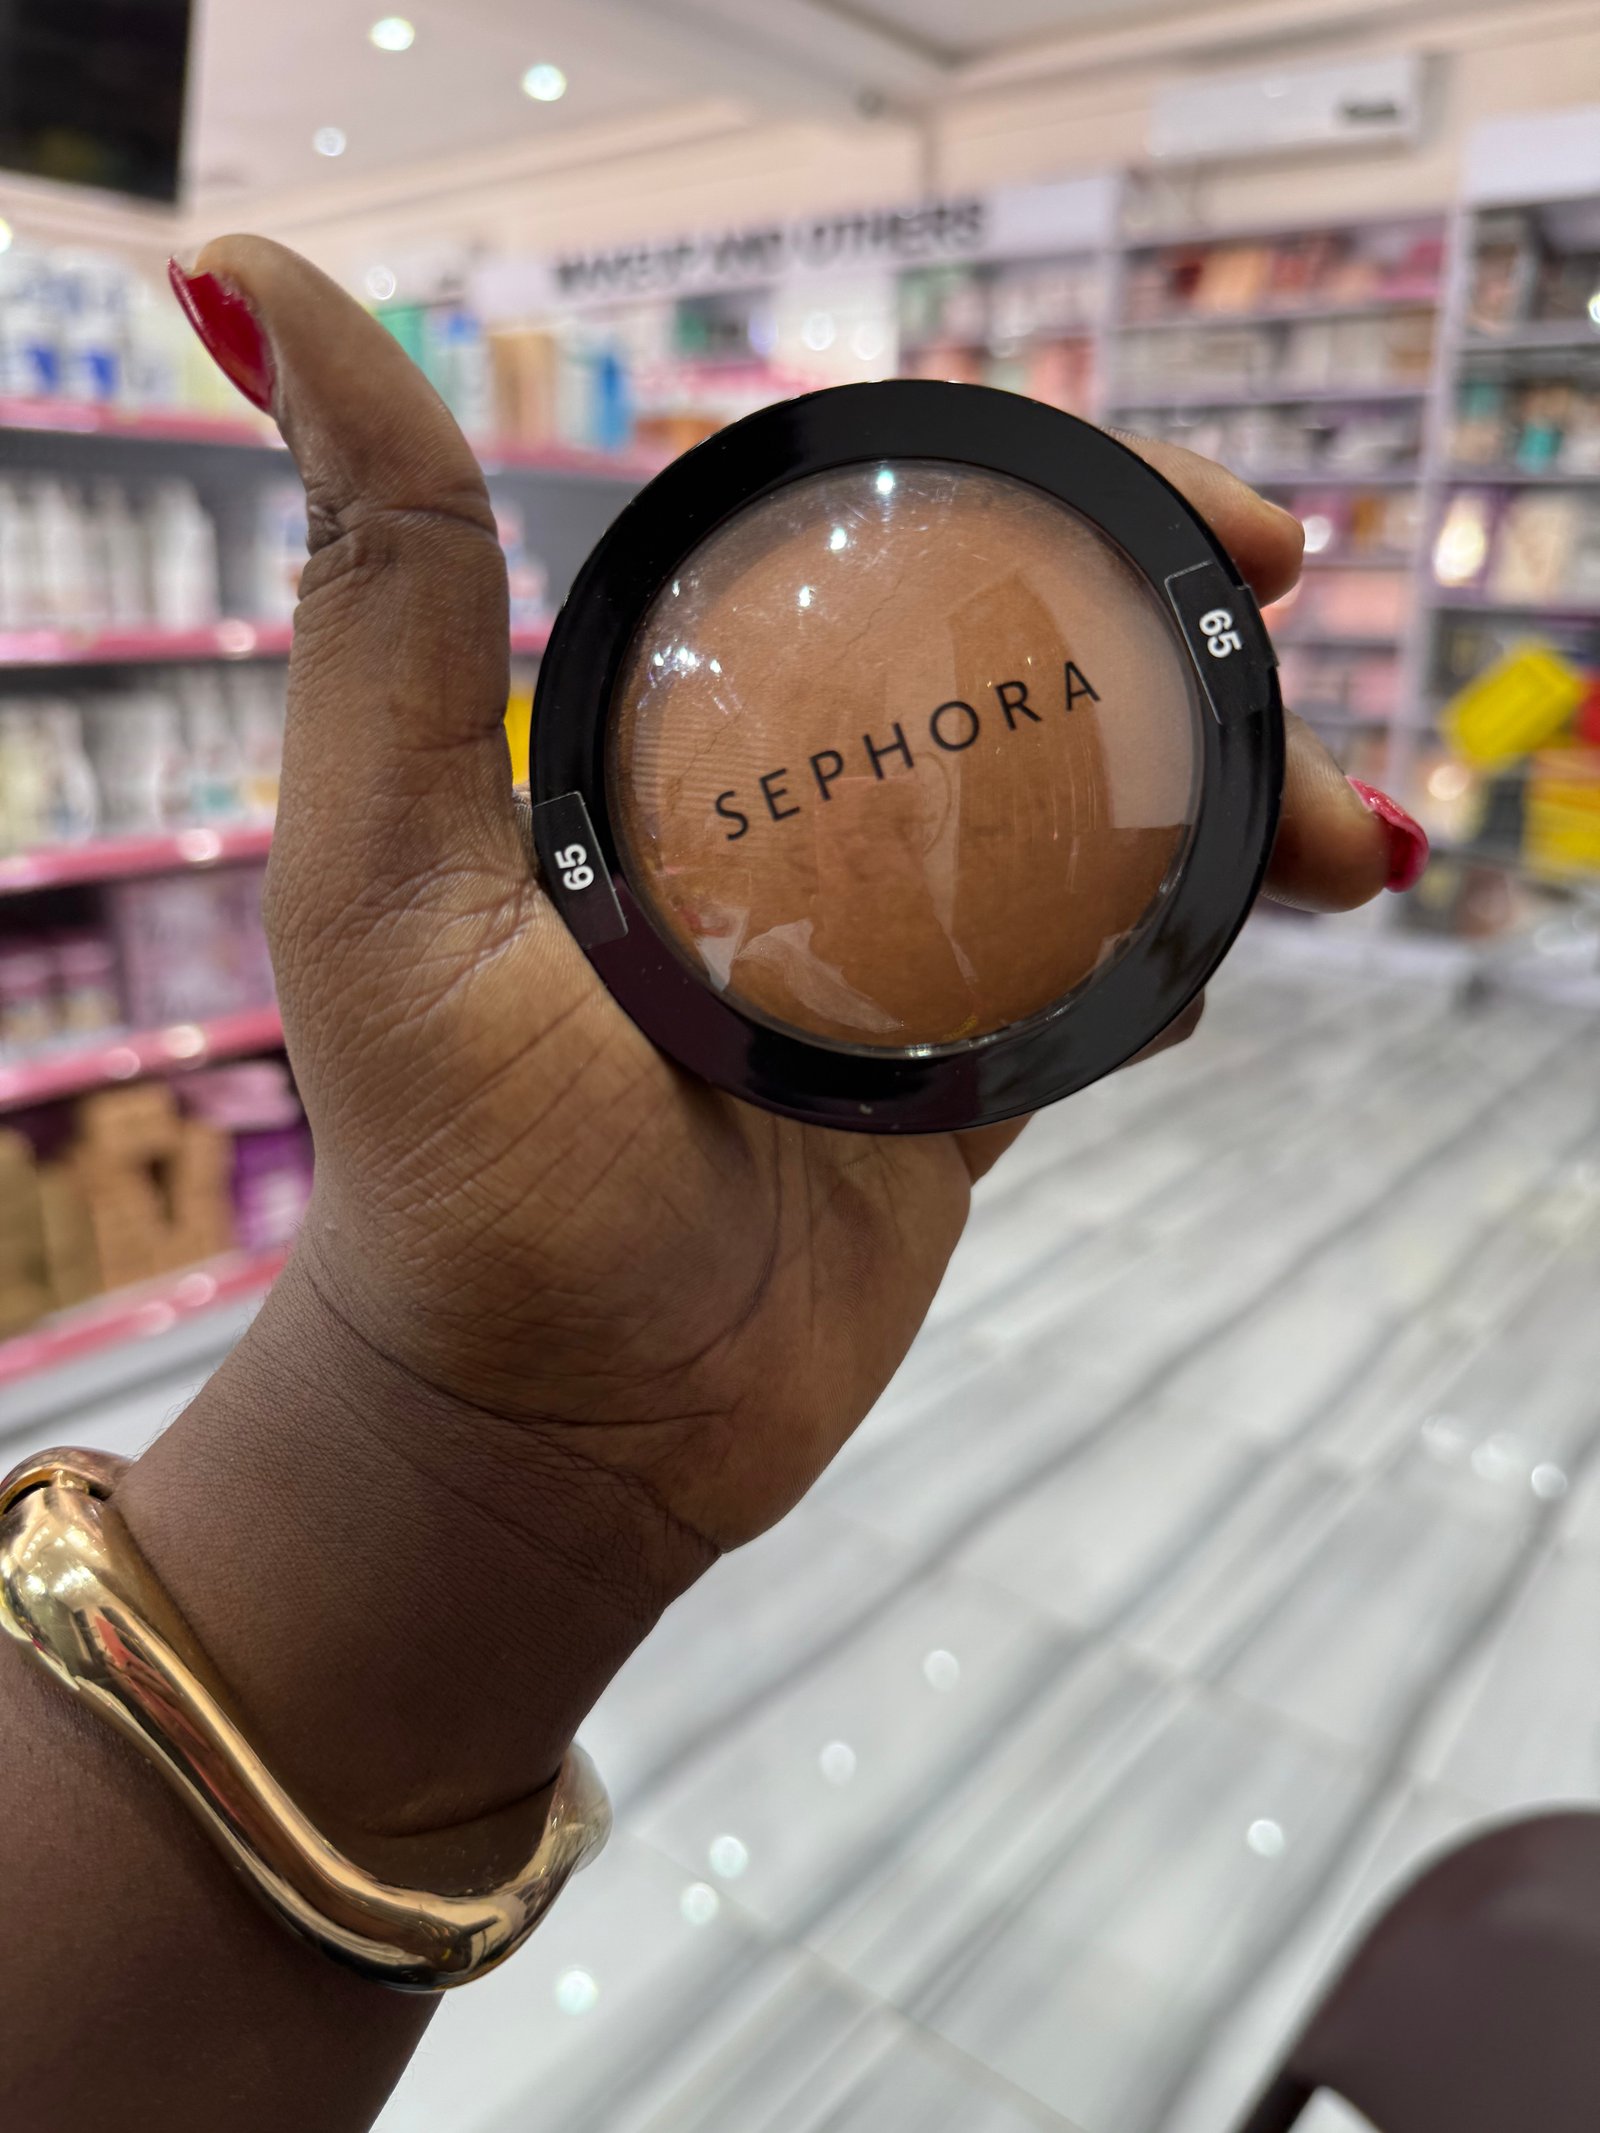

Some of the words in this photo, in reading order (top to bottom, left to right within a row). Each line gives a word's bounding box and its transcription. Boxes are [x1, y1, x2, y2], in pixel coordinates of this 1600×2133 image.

[1199, 608, 1242, 659] 65
[715, 660, 1101, 841] SEPHORA
[554, 843, 595, 891] 65
